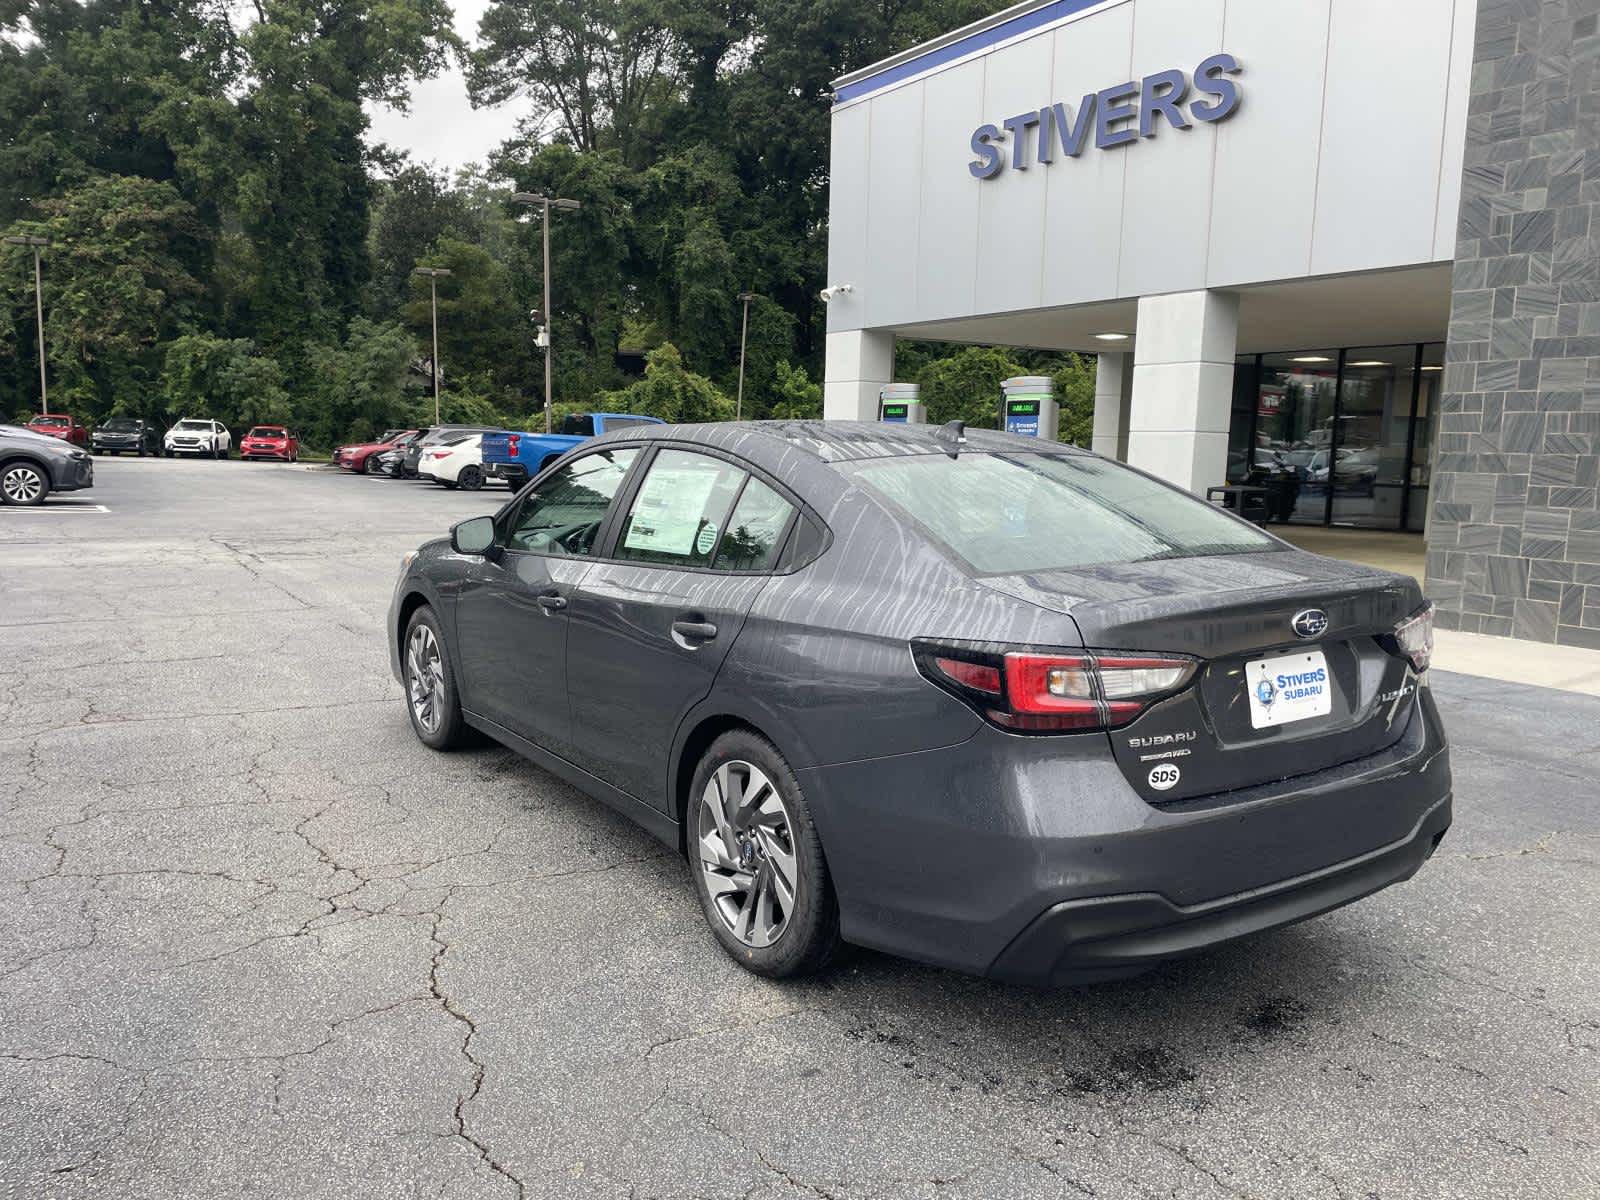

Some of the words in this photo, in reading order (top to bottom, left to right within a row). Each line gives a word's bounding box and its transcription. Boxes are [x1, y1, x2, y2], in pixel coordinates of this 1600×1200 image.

[968, 53, 1243, 180] STIVERS
[1276, 668, 1326, 689] STIVERS
[1284, 685, 1323, 701] SUBARU
[1128, 730, 1197, 748] SUBARU
[1151, 769, 1177, 783] SDS
